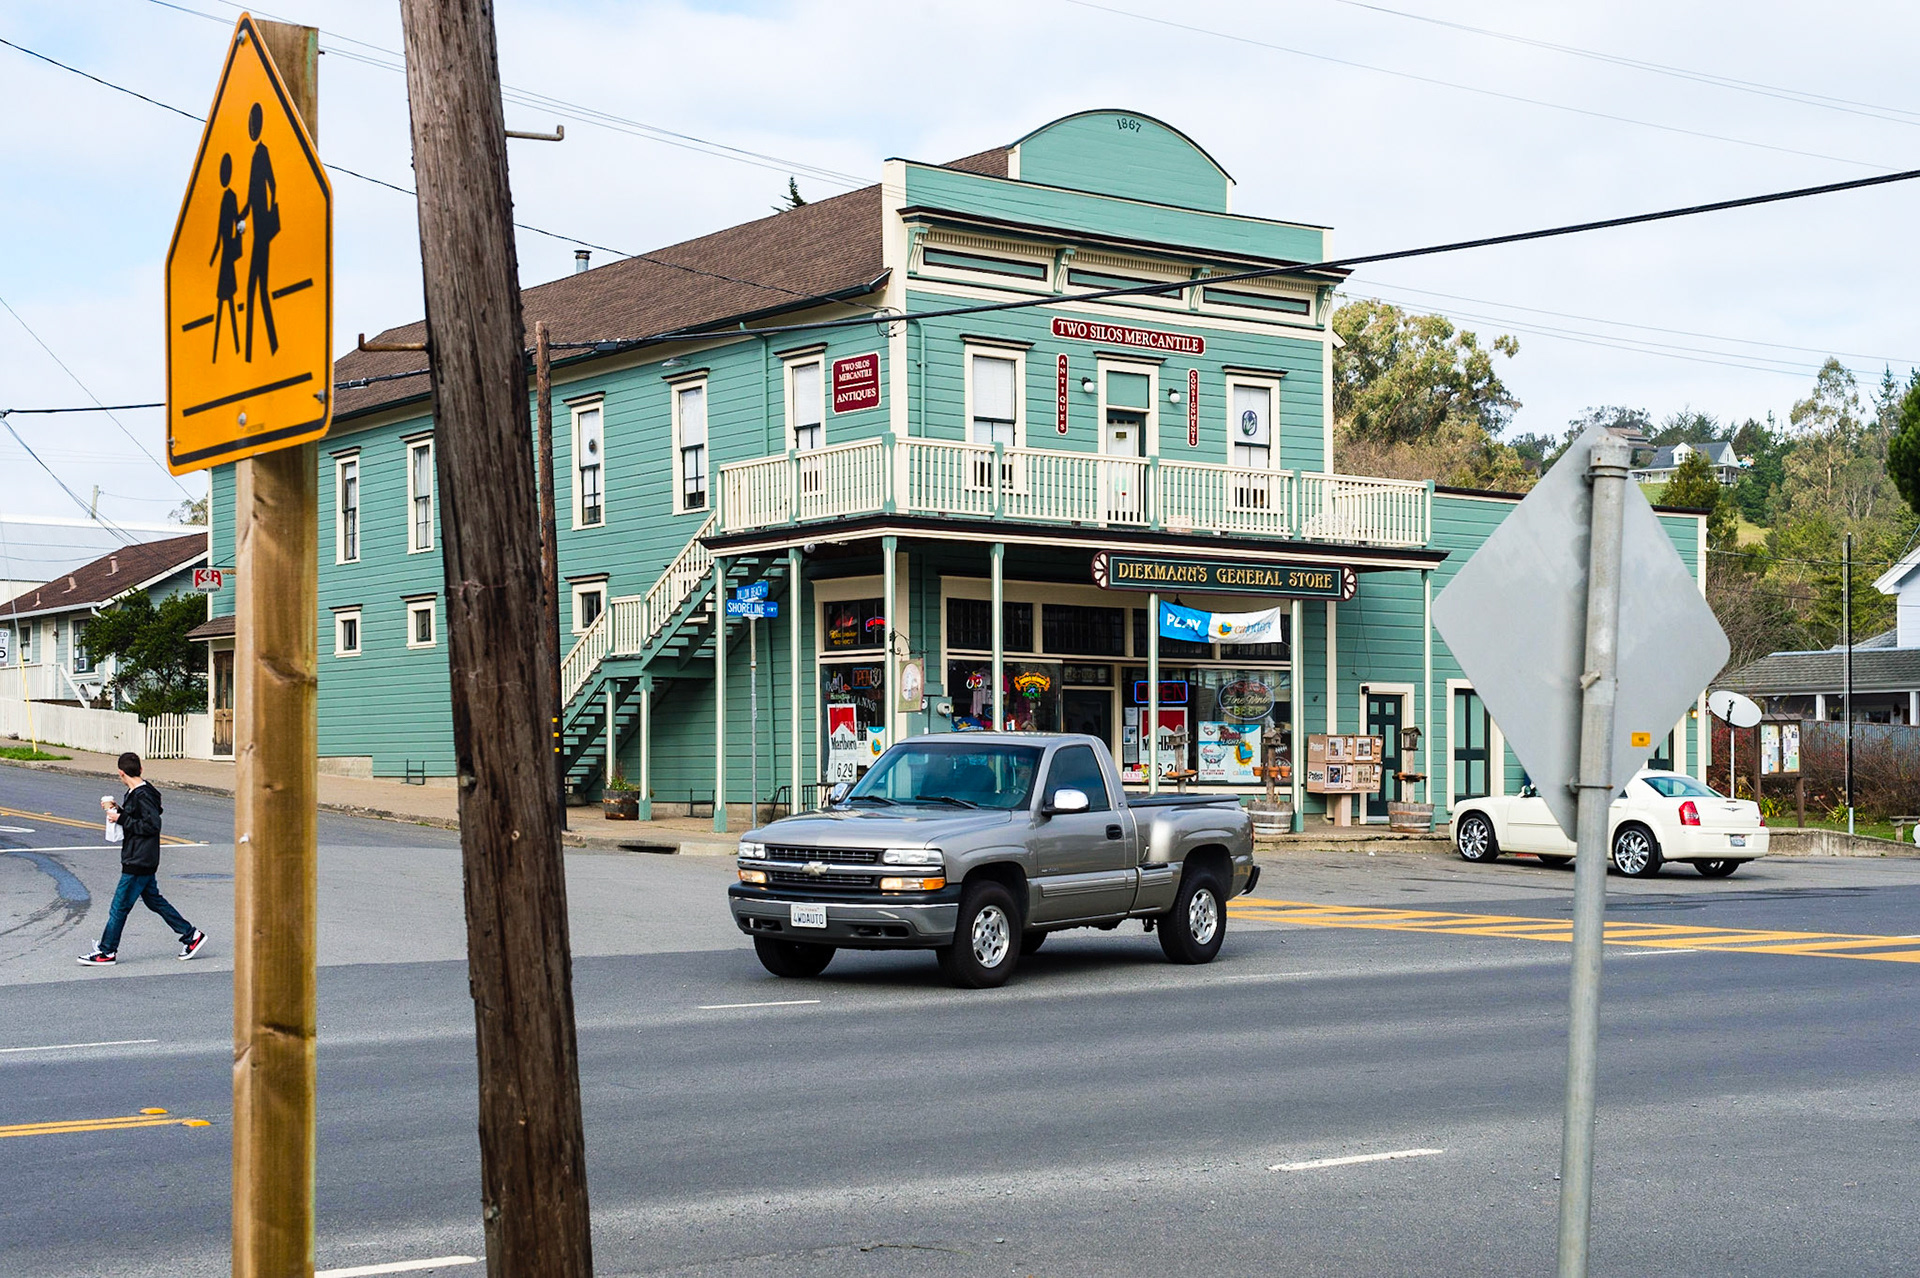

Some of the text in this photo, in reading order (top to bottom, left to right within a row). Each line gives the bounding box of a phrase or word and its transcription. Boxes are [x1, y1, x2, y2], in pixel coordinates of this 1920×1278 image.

[1117, 118, 1141, 133] 1867
[1057, 321, 1200, 351] TWO SILOS MERCANTILE
[841, 360, 870, 372] TWO SILOS
[838, 368, 872, 382] MERCANTILE
[836, 387, 876, 403] ANTIQUES
[1118, 562, 1333, 589] DIEKMANN'S GENERAL STORE
[727, 602, 765, 615] SHORELINE
[1166, 612, 1201, 631] PLAY
[1137, 683, 1186, 701] OEN
[1234, 706, 1261, 716] BEER
[831, 734, 857, 750] Marlboro
